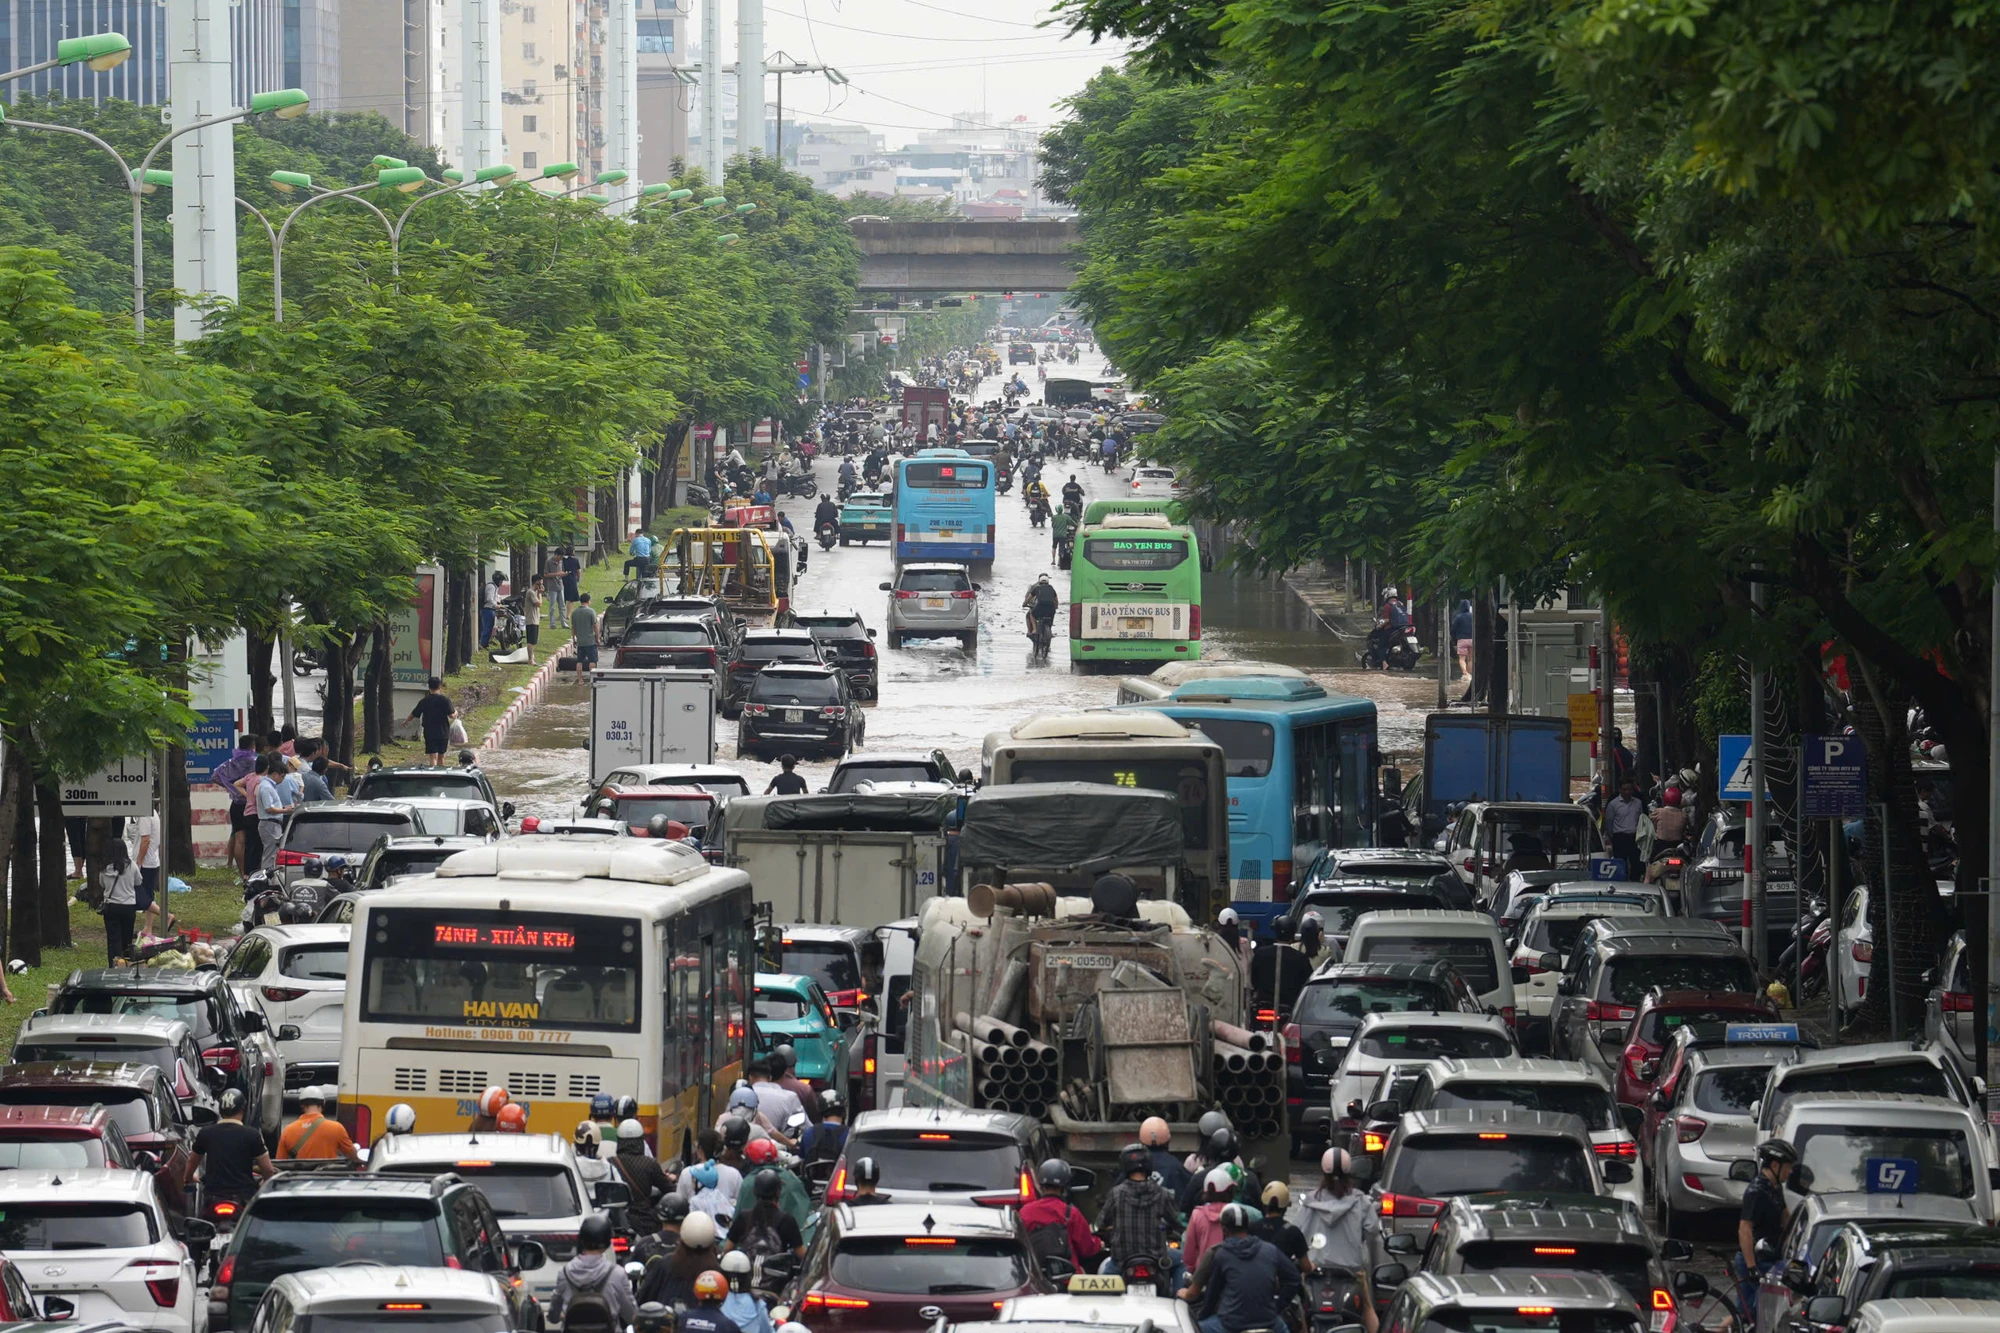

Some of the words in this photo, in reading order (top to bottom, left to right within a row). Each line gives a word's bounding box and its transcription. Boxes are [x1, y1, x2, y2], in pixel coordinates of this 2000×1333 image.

[1134, 542, 1153, 550] YEN
[1154, 542, 1173, 550] BUS
[1137, 607, 1153, 616] CNG
[1155, 607, 1171, 616] BUS
[611, 720, 627, 730] 34D
[605, 731, 633, 741] 030.31
[187, 738, 229, 749] ANH
[1825, 741, 1844, 765] P
[1114, 773, 1136, 788] 74
[65, 789, 99, 800] 300m
[1599, 861, 1617, 879] G7
[463, 1000, 496, 1017] HAI
[498, 1001, 539, 1020] VAN
[466, 1018, 498, 1027] CITY
[502, 1019, 531, 1028] BUS
[425, 1026, 477, 1040] Hotline:
[517, 1030, 535, 1042] 00
[539, 1031, 572, 1043] 7777
[1879, 1162, 1906, 1190] G7
[1079, 1278, 1116, 1289] TAXI
